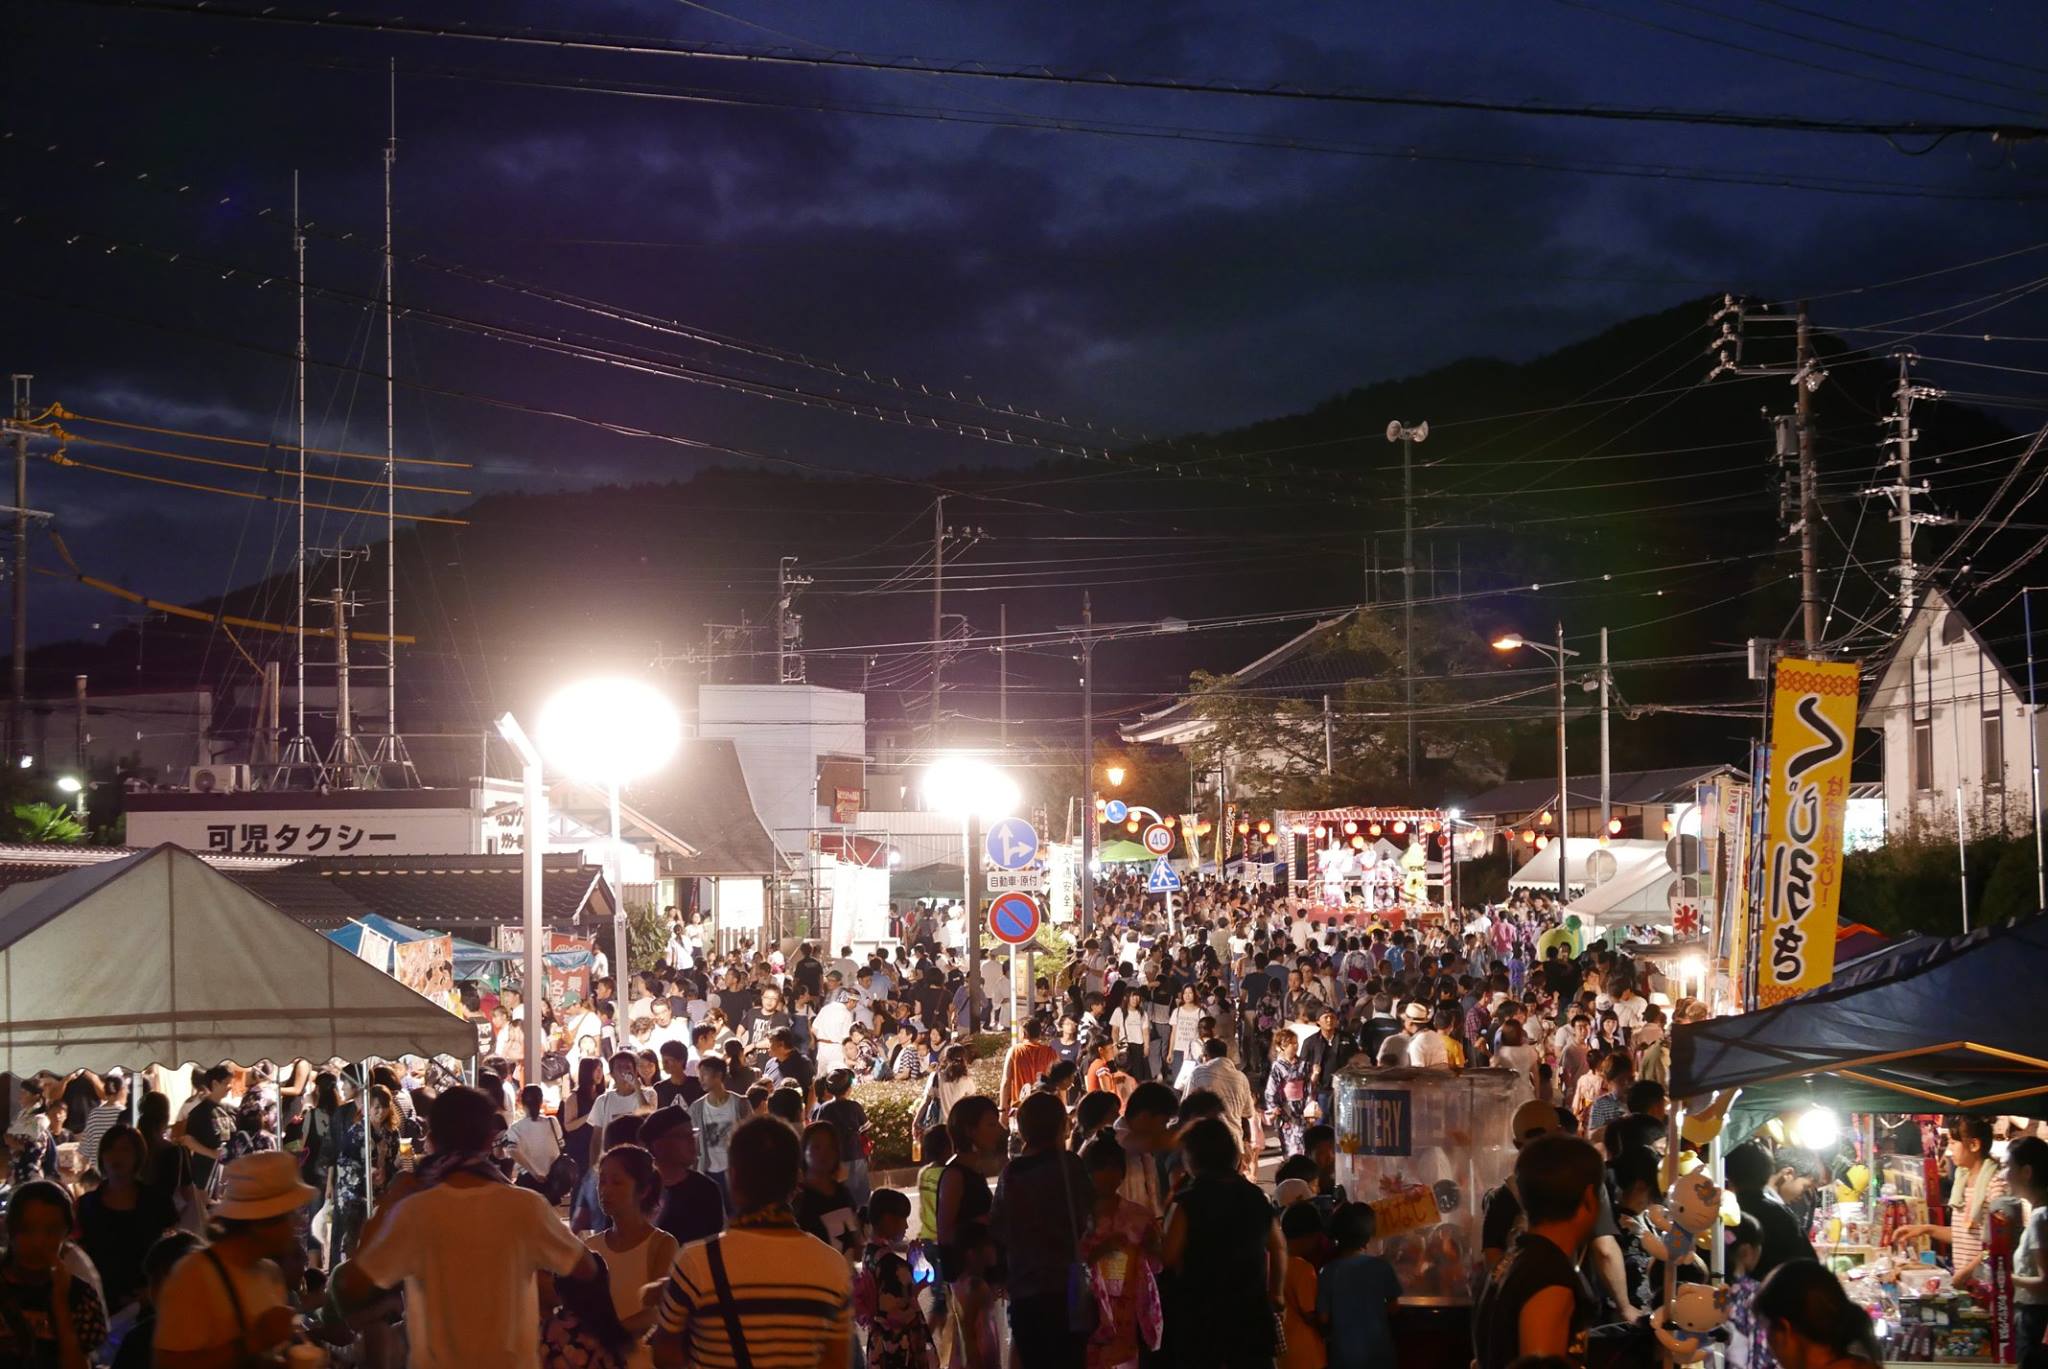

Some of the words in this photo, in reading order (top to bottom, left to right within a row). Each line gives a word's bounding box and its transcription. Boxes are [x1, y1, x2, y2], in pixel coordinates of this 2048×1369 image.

[207, 824, 397, 853] 可児タクシー
[1151, 832, 1168, 846] 40
[1773, 697, 1844, 981] くじ引き
[1674, 904, 1698, 936] 氷
